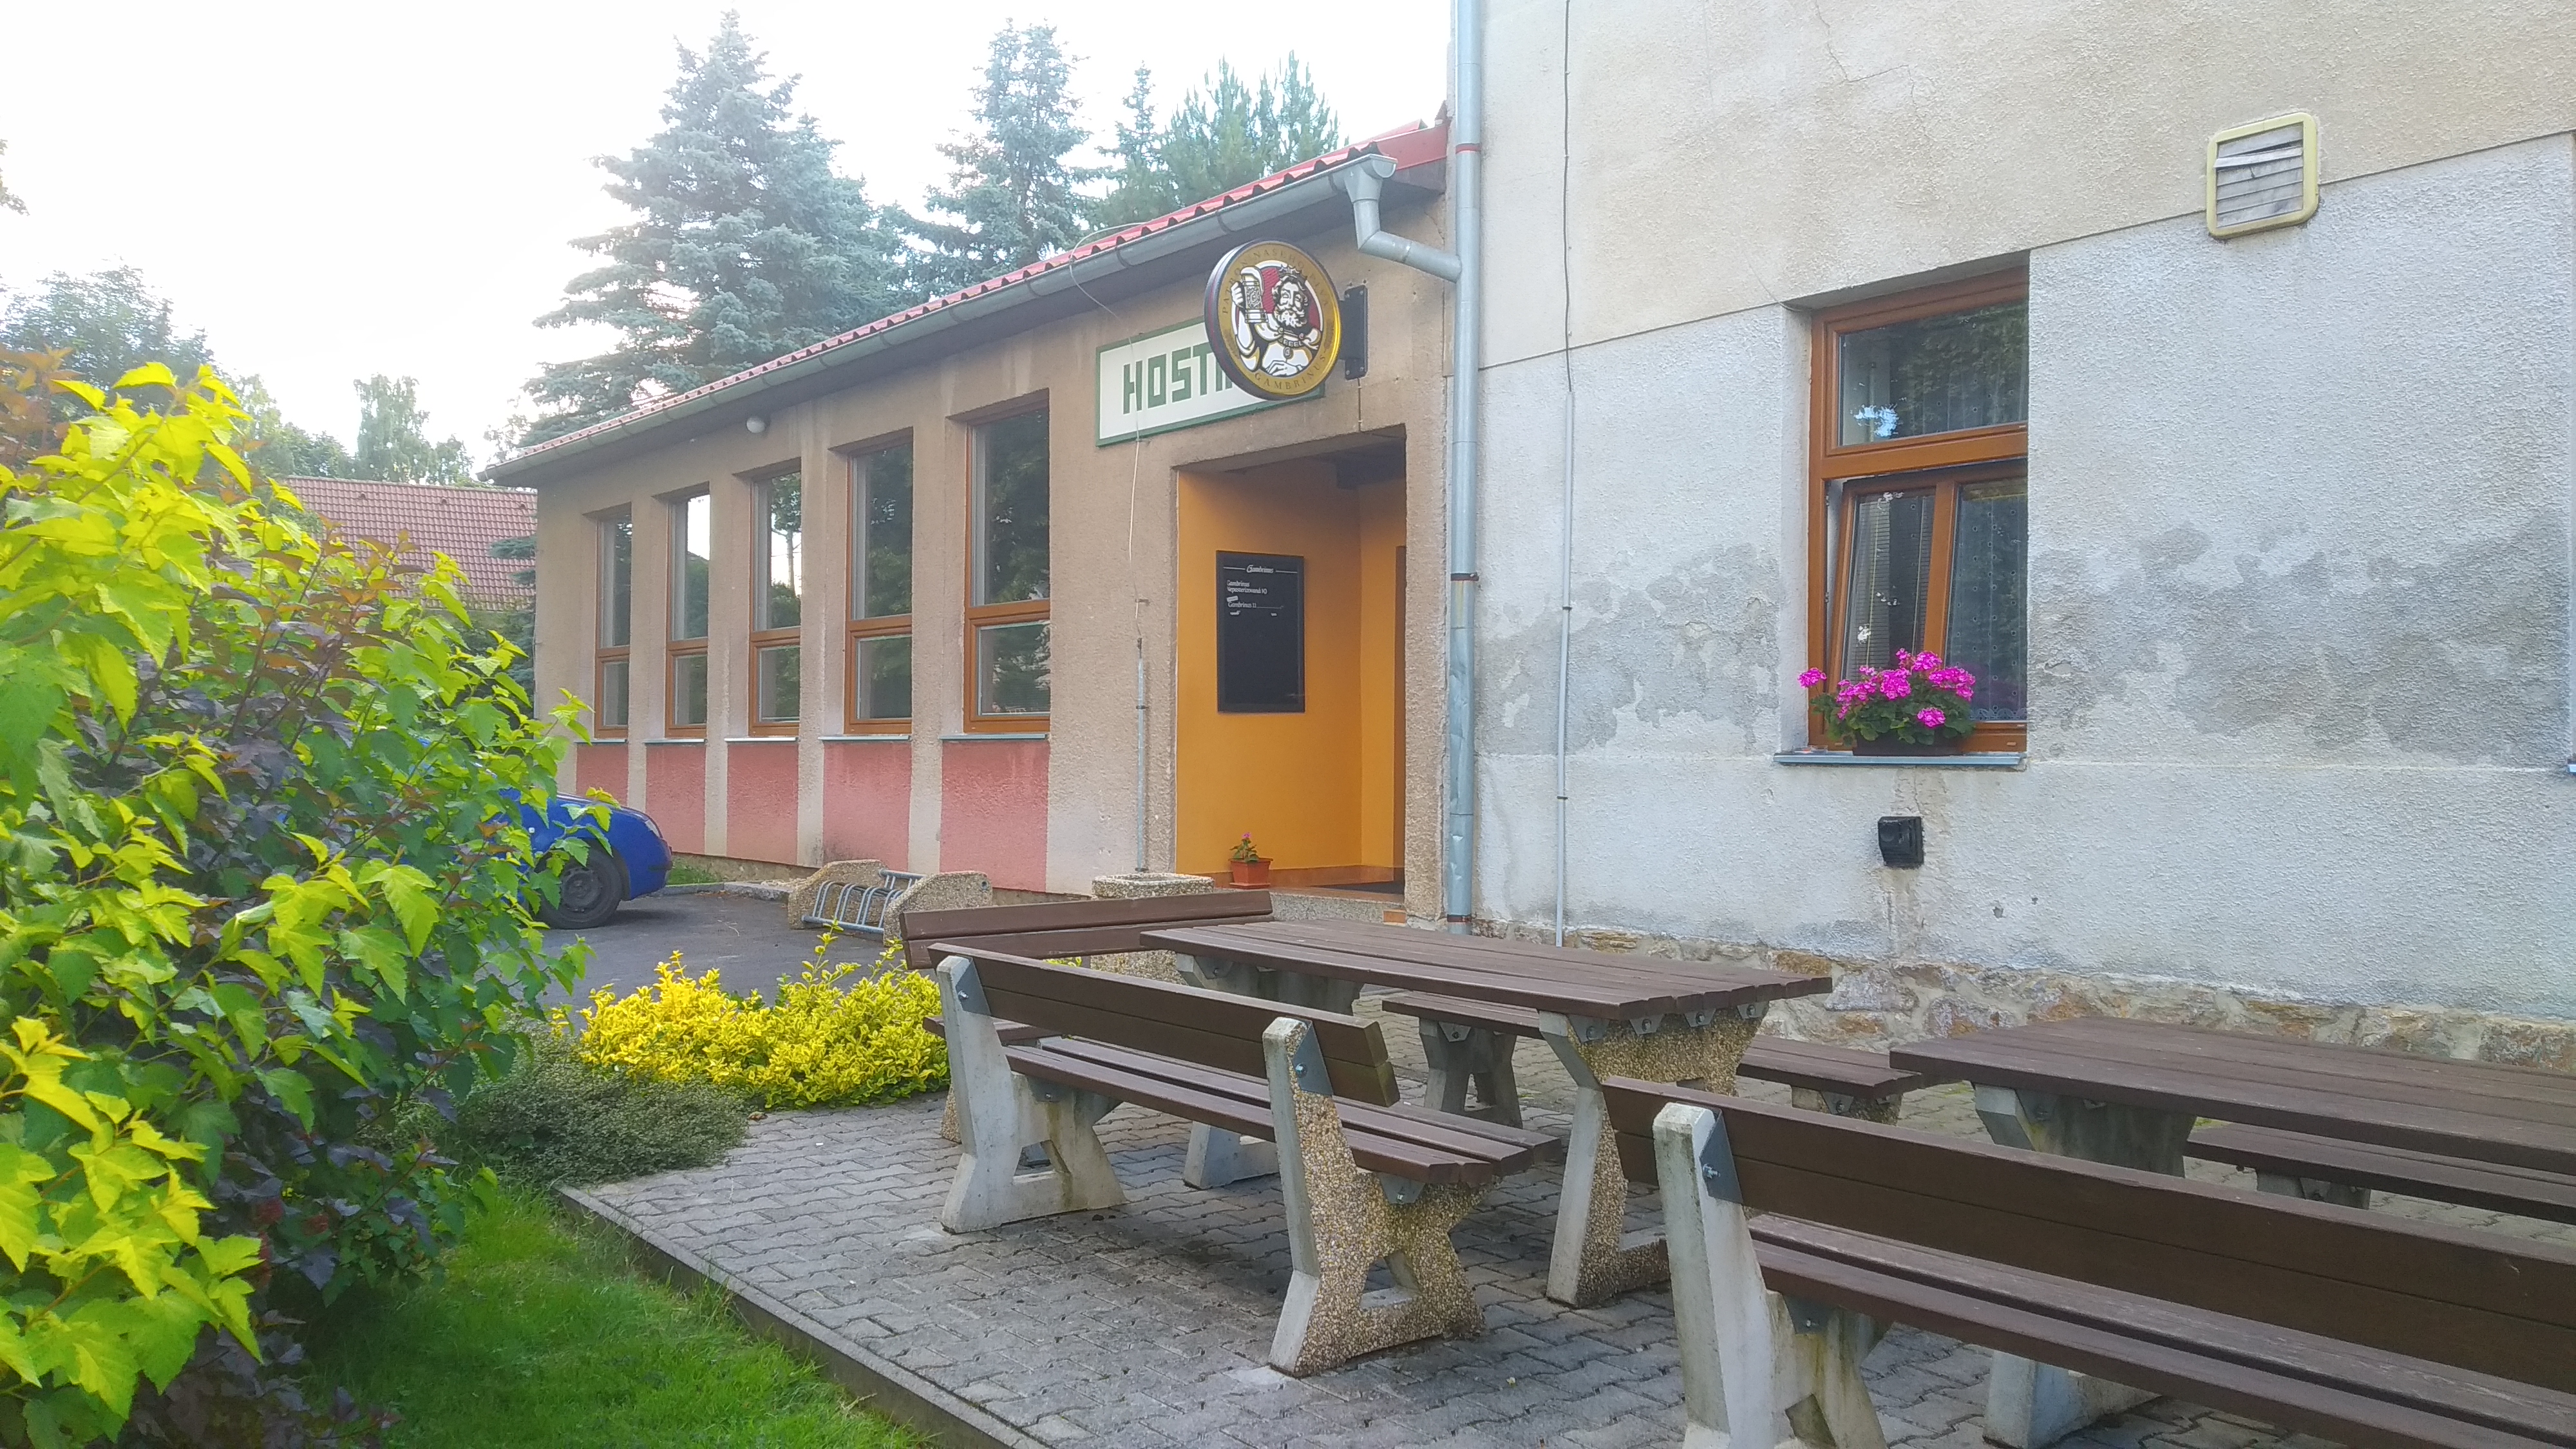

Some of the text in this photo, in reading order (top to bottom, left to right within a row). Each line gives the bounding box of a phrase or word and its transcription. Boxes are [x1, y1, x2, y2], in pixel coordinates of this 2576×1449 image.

[1123, 342, 1233, 415] HOSTI
[1255, 354, 1325, 390] GAMBRINUS
[1246, 565, 1274, 573] Gambrinus
